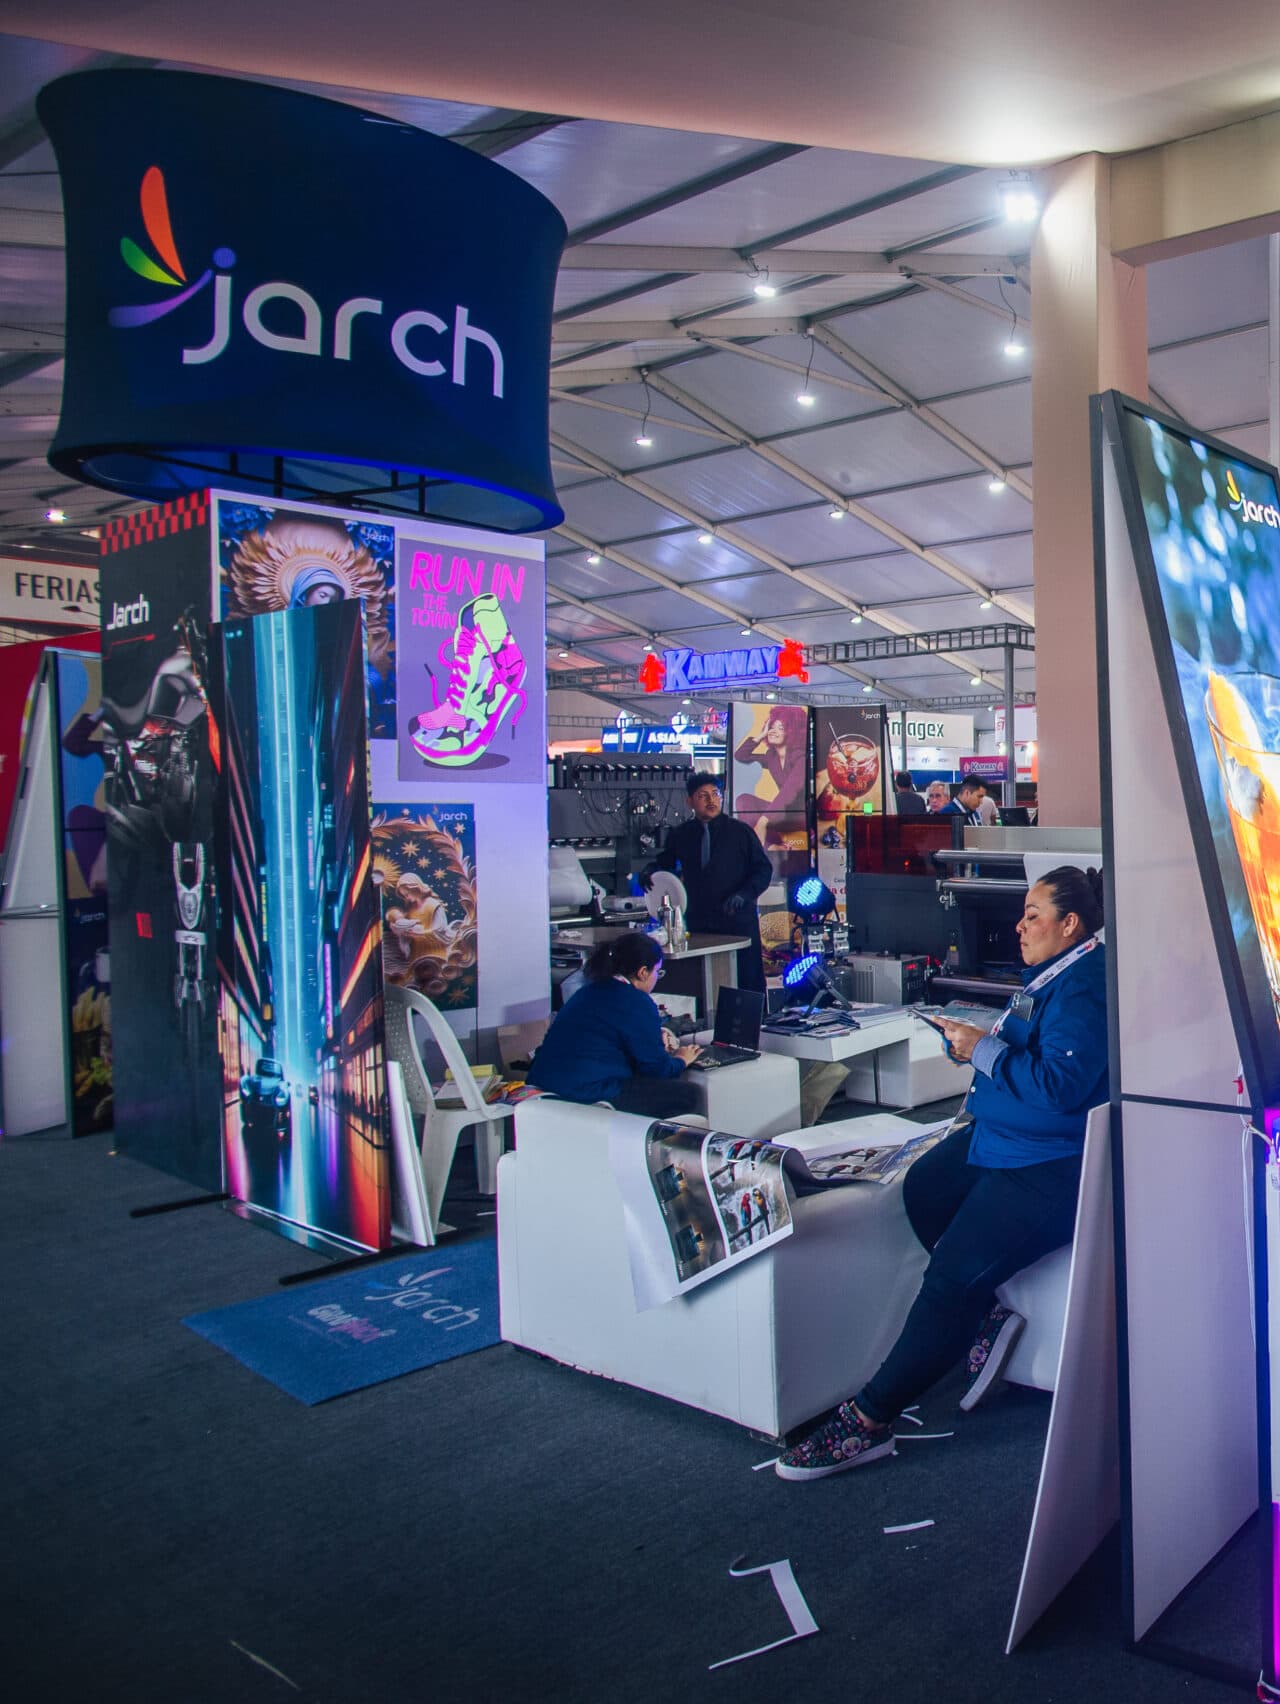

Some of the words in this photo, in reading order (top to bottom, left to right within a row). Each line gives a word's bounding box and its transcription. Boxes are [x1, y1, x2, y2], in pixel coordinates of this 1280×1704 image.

[182, 247, 504, 399] jarch
[409, 551, 485, 596] RUN
[490, 562, 525, 604] IN
[412, 608, 458, 630] TOWN
[423, 593, 448, 611] THE
[439, 811, 468, 823] jarch
[364, 1284, 481, 1331] jarch
